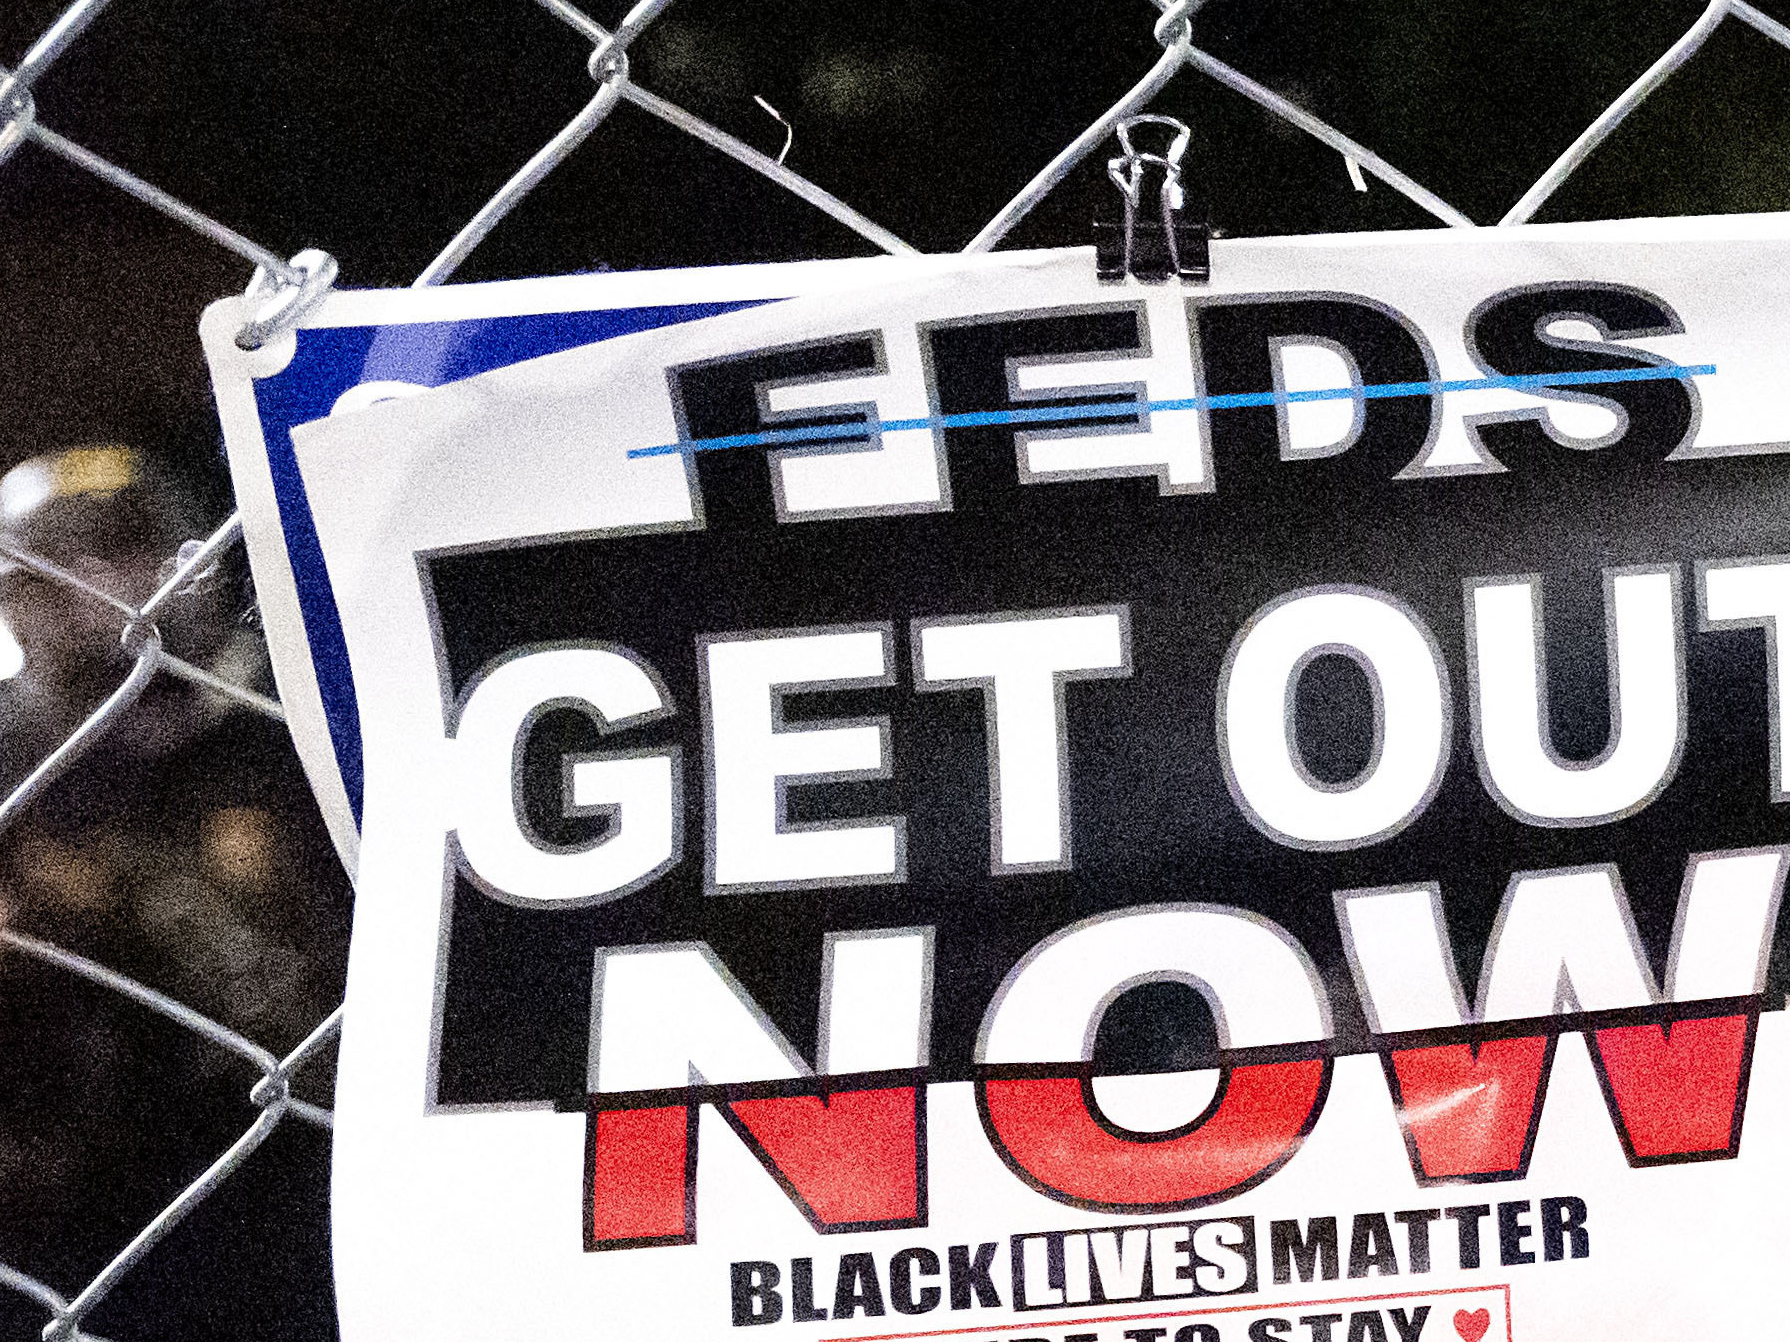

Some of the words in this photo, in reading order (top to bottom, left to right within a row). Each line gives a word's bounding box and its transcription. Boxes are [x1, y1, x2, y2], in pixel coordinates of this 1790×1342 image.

[666, 281, 1706, 529] FEDS
[447, 605, 1130, 909] GET
[730, 1242, 1001, 1327] BLACK
[1019, 1220, 1252, 1311] LIVES
[1271, 1195, 1591, 1286] MATTER
